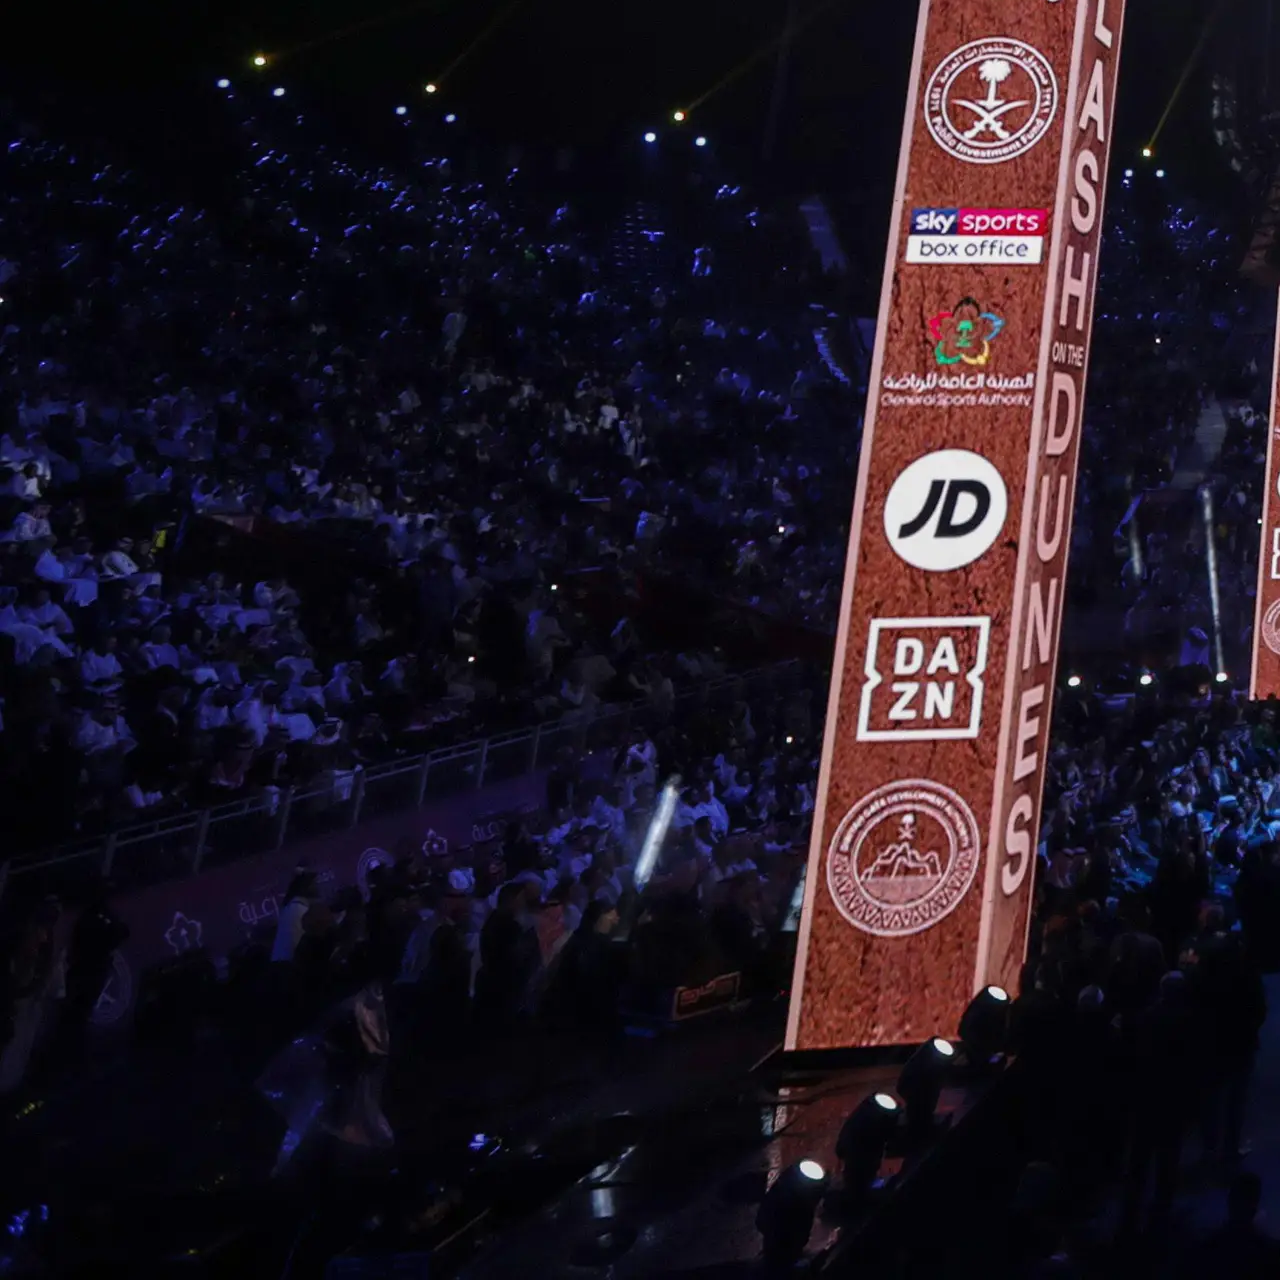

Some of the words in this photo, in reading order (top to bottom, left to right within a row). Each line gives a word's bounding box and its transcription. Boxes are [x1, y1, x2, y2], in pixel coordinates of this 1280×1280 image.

[955, 140, 1022, 159] Investment
[915, 212, 957, 234] sky
[962, 212, 1040, 233] sports
[919, 239, 959, 257] box
[964, 239, 1029, 258] office
[1052, 341, 1067, 363] ON
[1067, 342, 1085, 367] THE
[938, 371, 985, 390] العامة
[898, 479, 991, 539] JD
[1001, 372, 1077, 897] DUNES
